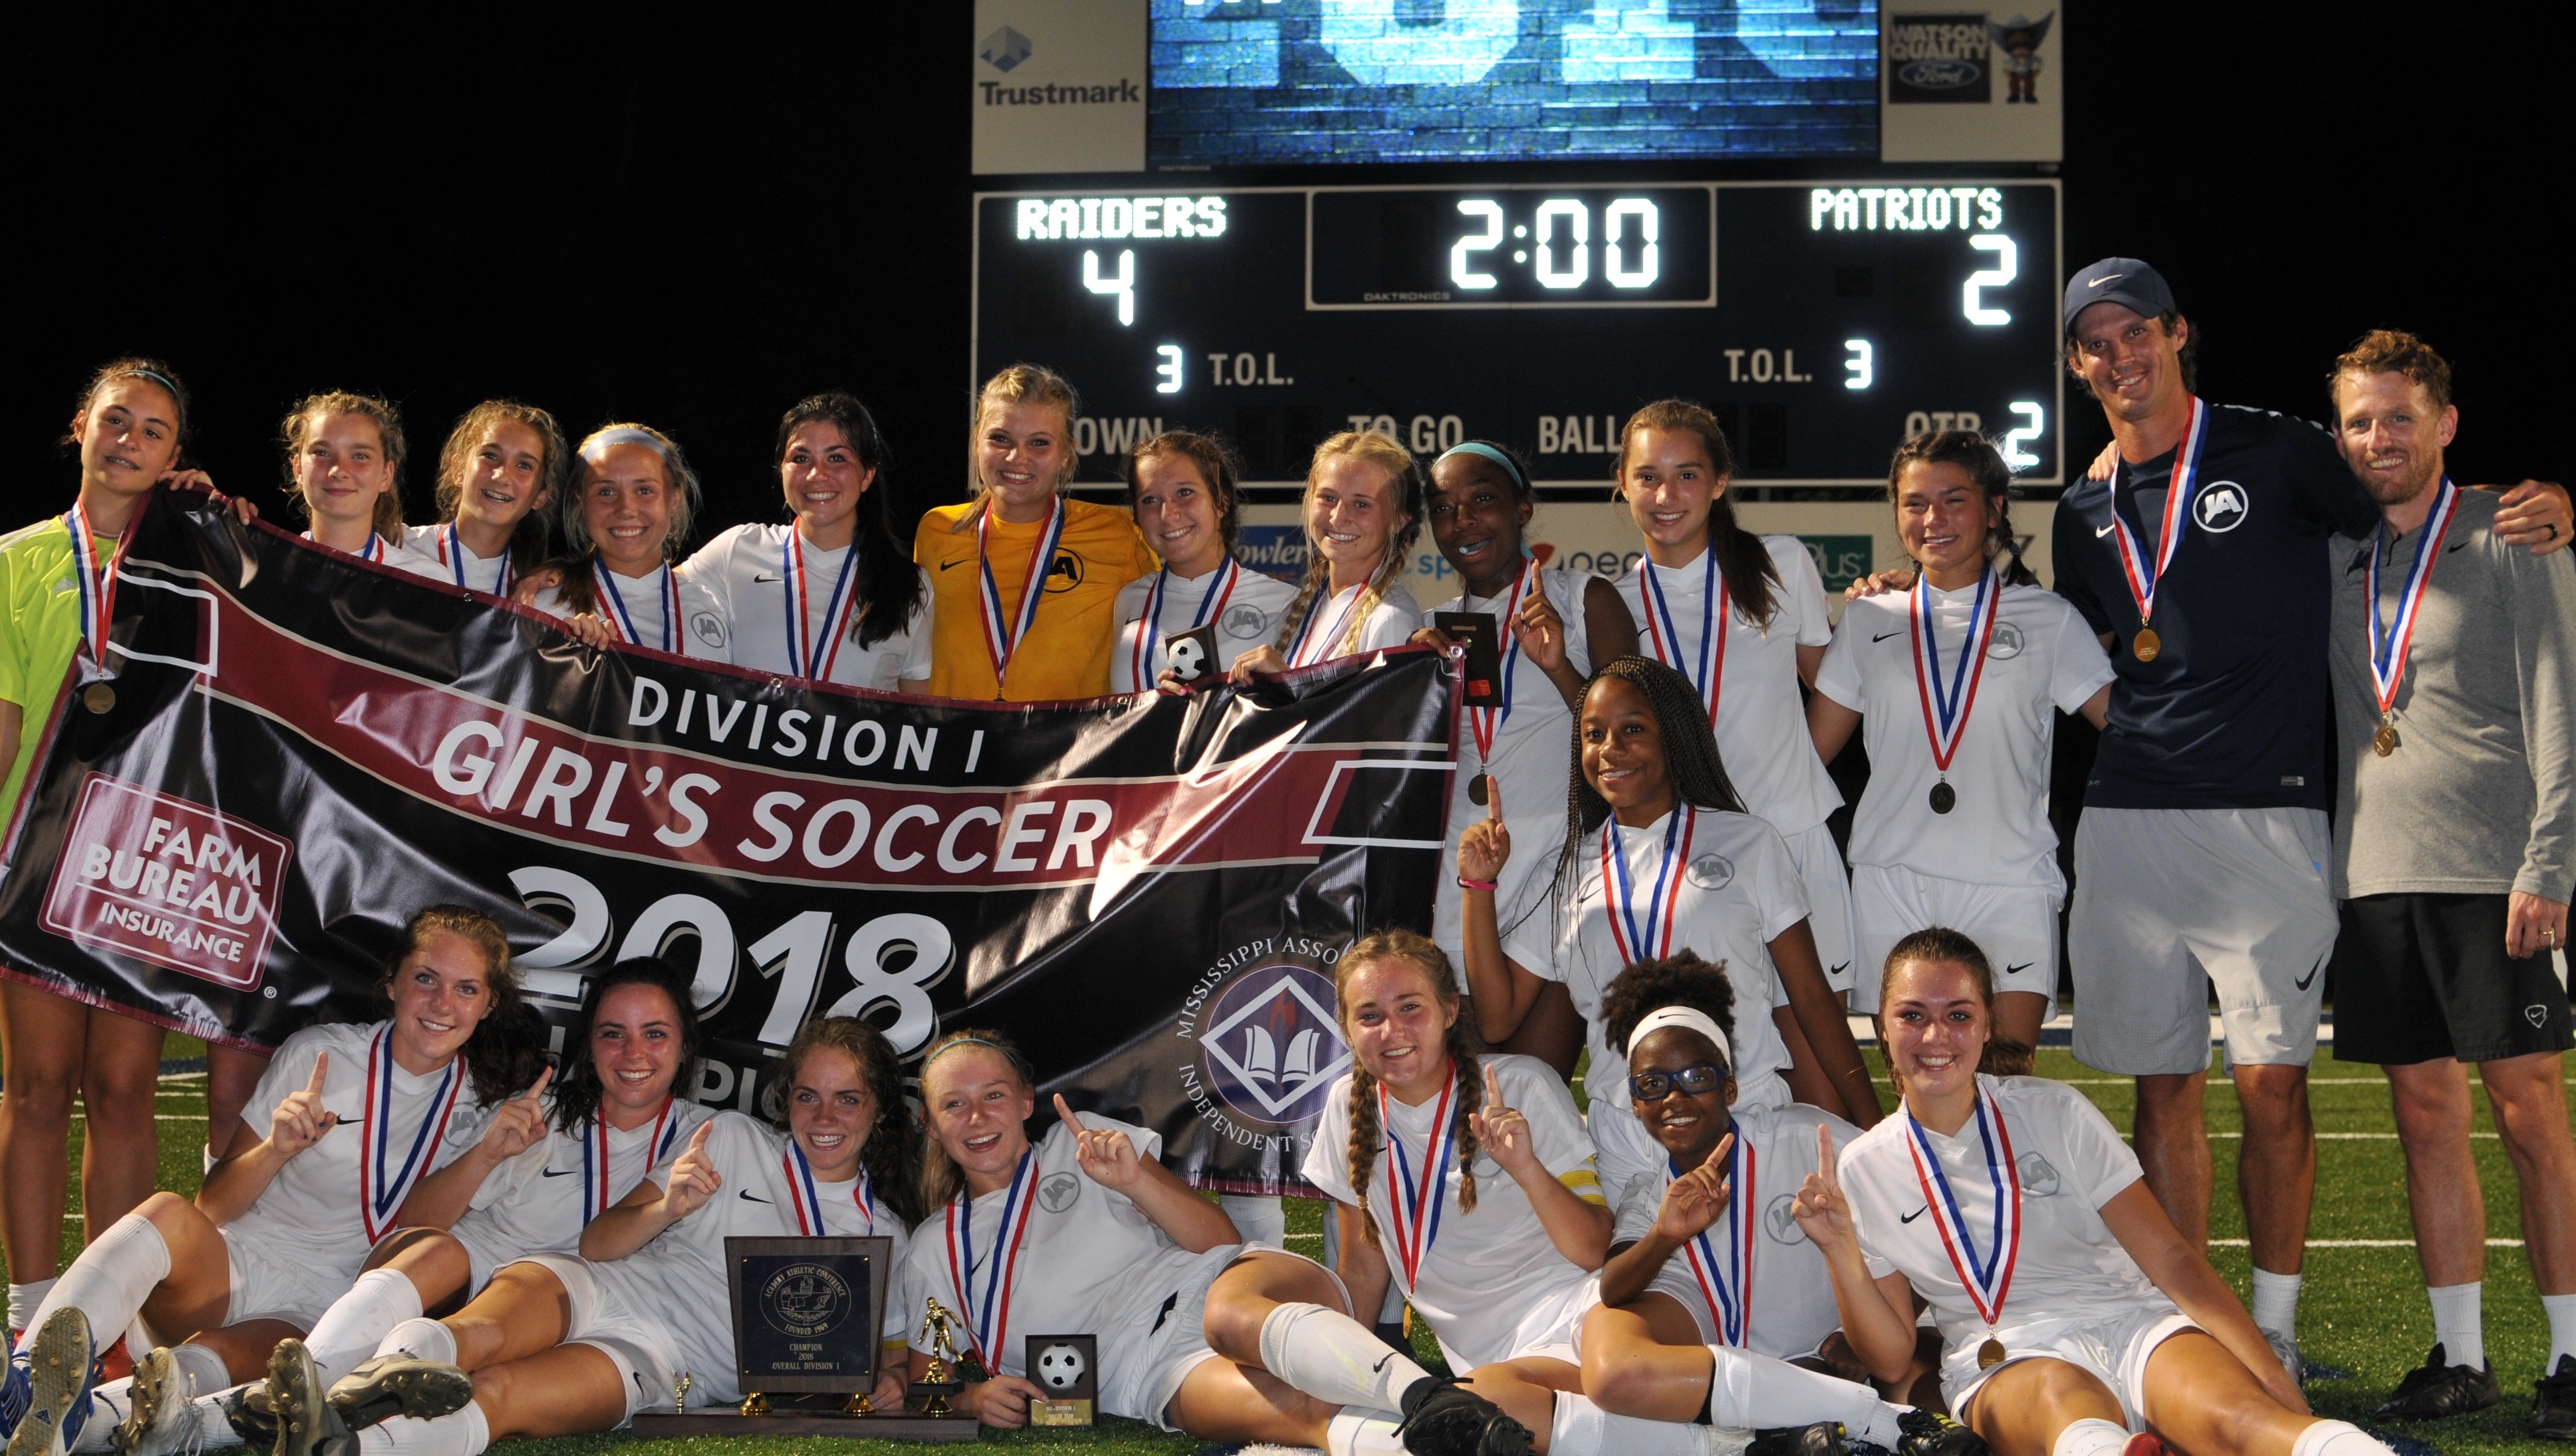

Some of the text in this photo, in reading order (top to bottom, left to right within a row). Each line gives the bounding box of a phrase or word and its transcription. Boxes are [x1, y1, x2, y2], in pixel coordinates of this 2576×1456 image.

[1890, 43, 1988, 59] QUALITY
[980, 79, 1139, 106] Trustmark
[1017, 197, 1227, 240] RAIDERS
[1811, 187, 2002, 231] PATRIOTS
[1451, 198, 1659, 289] 2:00
[1084, 249, 1134, 326] 4
[1964, 234, 2017, 326] 2
[1157, 345, 1183, 393] 3
[1209, 353, 1294, 386] T.O.L.
[1724, 349, 1812, 384] T.O.L.
[1844, 340, 1872, 390] 3
[1074, 416, 1163, 456] OWN
[1410, 414, 1464, 453] GO
[1538, 415, 1622, 453] BALL
[2006, 402, 2043, 465] 2
[1237, 535, 1308, 565] owler
[629, 676, 985, 774] DIVISION I
[432, 720, 1113, 874] GIRL'S SOCCER
[143, 816, 262, 888] FARM
[80, 842, 260, 926] BUREAU
[99, 901, 245, 963] INSURANCE
[507, 866, 956, 1060] 2018
[1177, 936, 1339, 1040] MISSISSIPPI ASSO
[1178, 1063, 1293, 1152] INDEPENDENT
[764, 1266, 847, 1299] ACADEMY ATHLETIC CONFERENCE
[785, 1322, 829, 1335] FOUNDED 1969
[789, 1343, 823, 1351] CHAMPION
[772, 1361, 800, 1370] OVERALL
[804, 1361, 833, 1370] DIVISION
